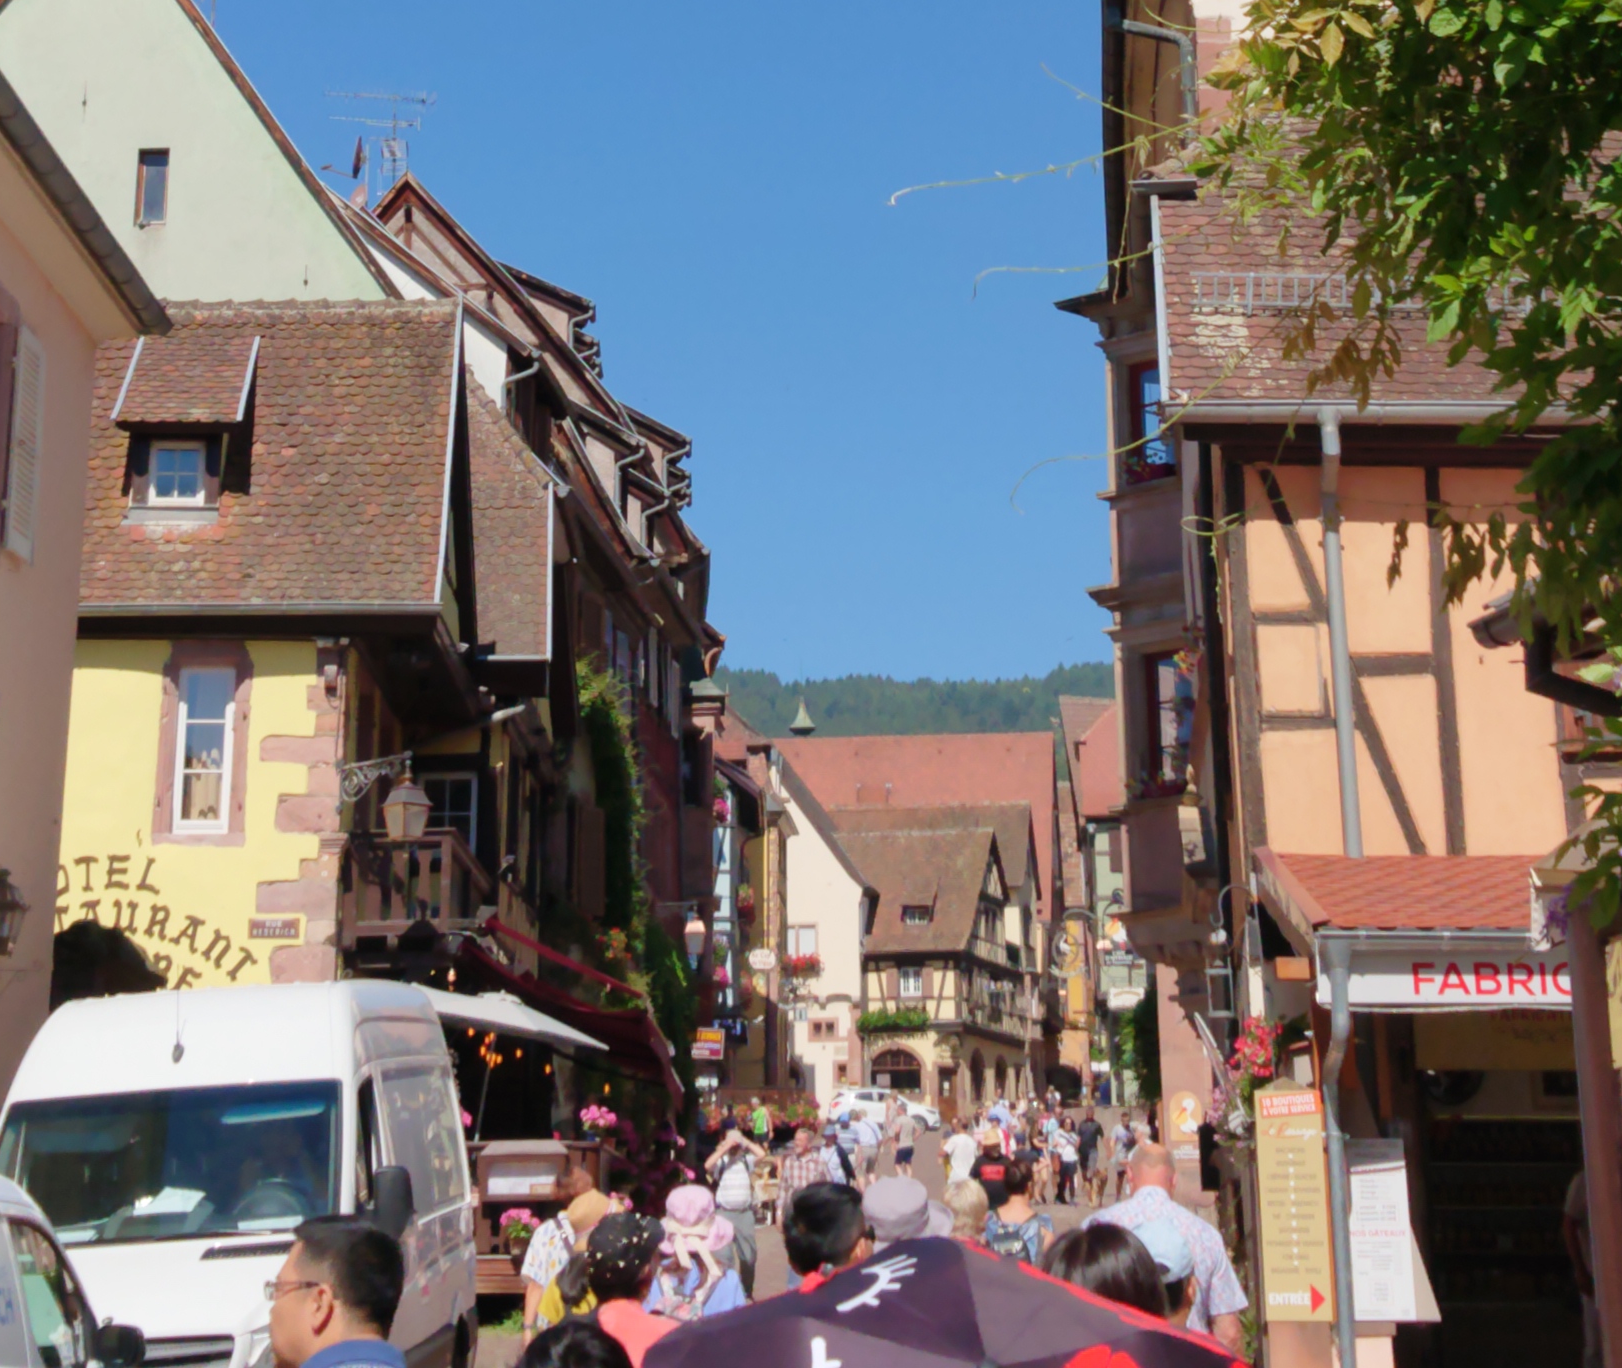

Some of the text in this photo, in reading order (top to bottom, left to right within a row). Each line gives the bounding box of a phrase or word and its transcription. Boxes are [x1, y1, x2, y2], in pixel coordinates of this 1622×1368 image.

[1272, 1093, 1315, 1106] BOUTIQUES
[1269, 1105, 1288, 1115] VOTRE
[1290, 1103, 1316, 1113] SERVICE
[1268, 1290, 1310, 1305] ENTRÉE
